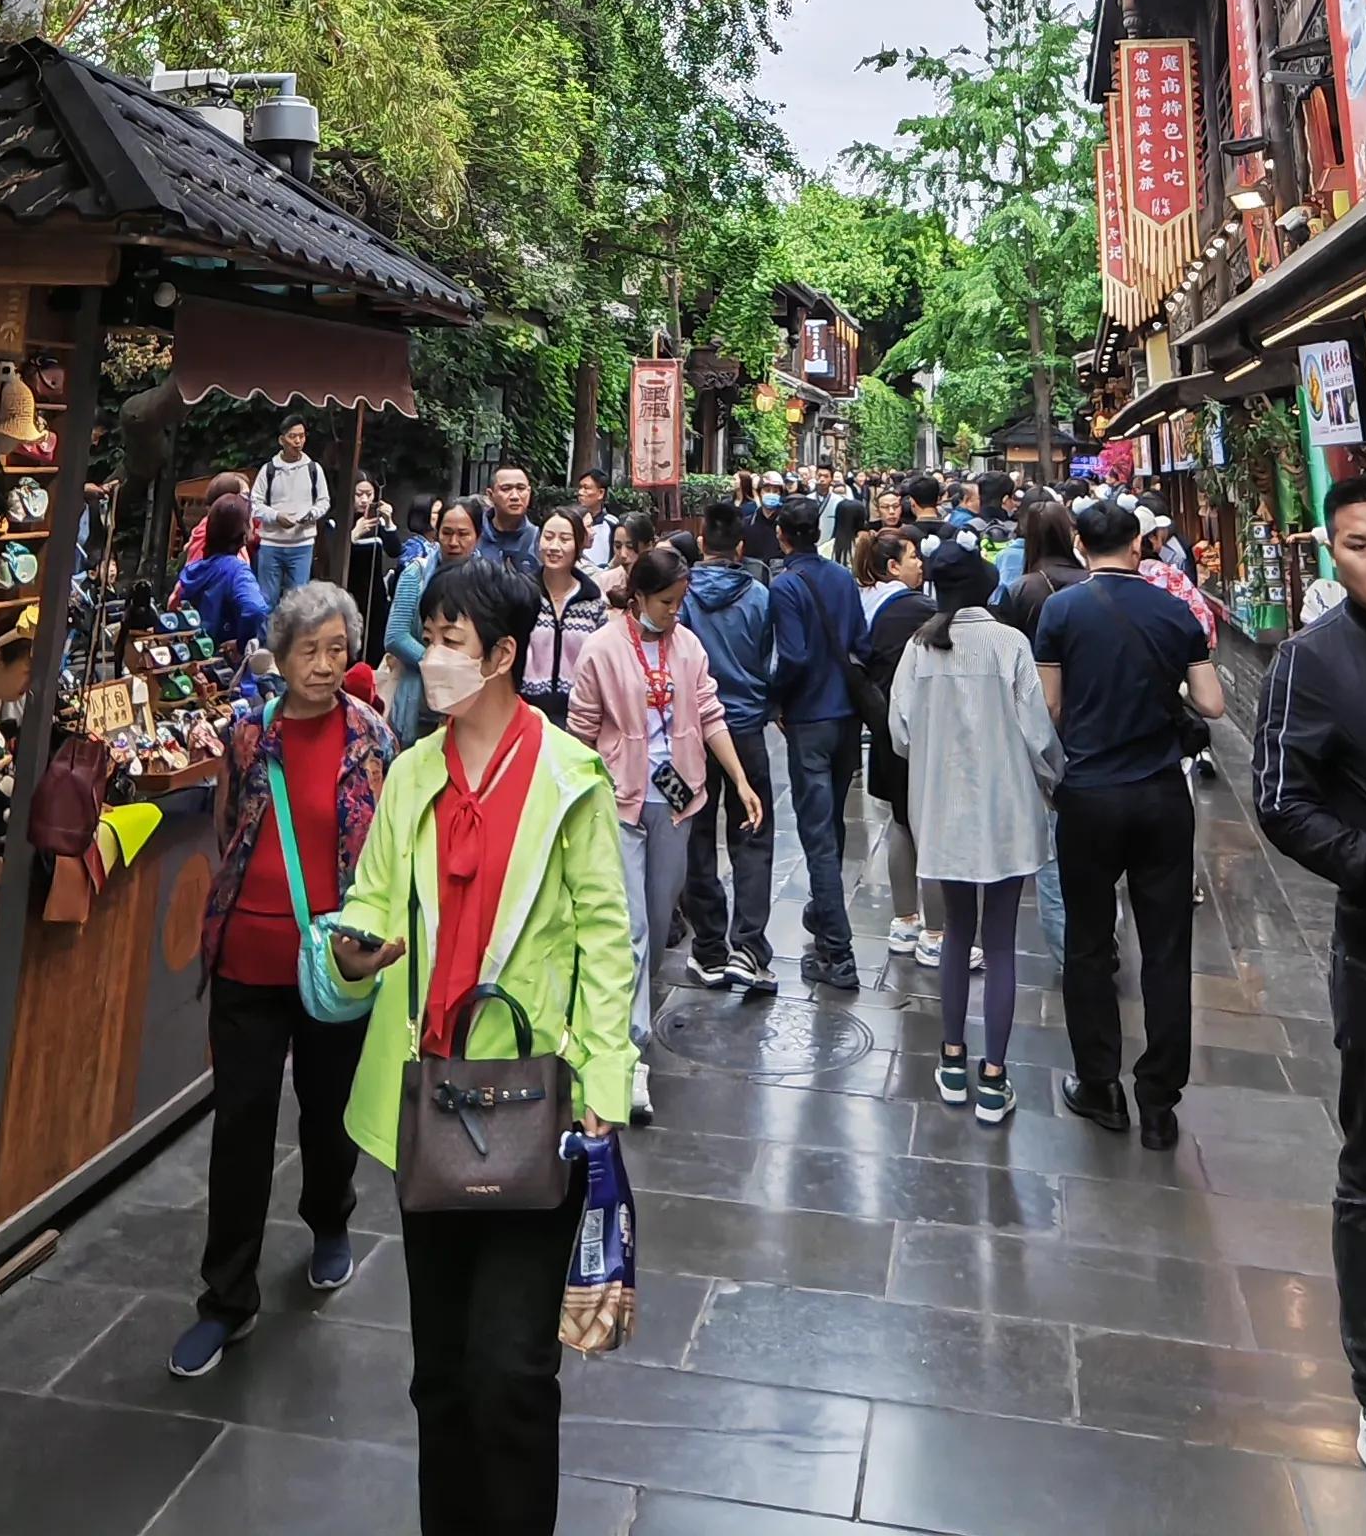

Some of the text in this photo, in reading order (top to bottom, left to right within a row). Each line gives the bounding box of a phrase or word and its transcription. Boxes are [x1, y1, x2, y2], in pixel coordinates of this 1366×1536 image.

[1159, 54, 1185, 187] 魔高特色小吃
